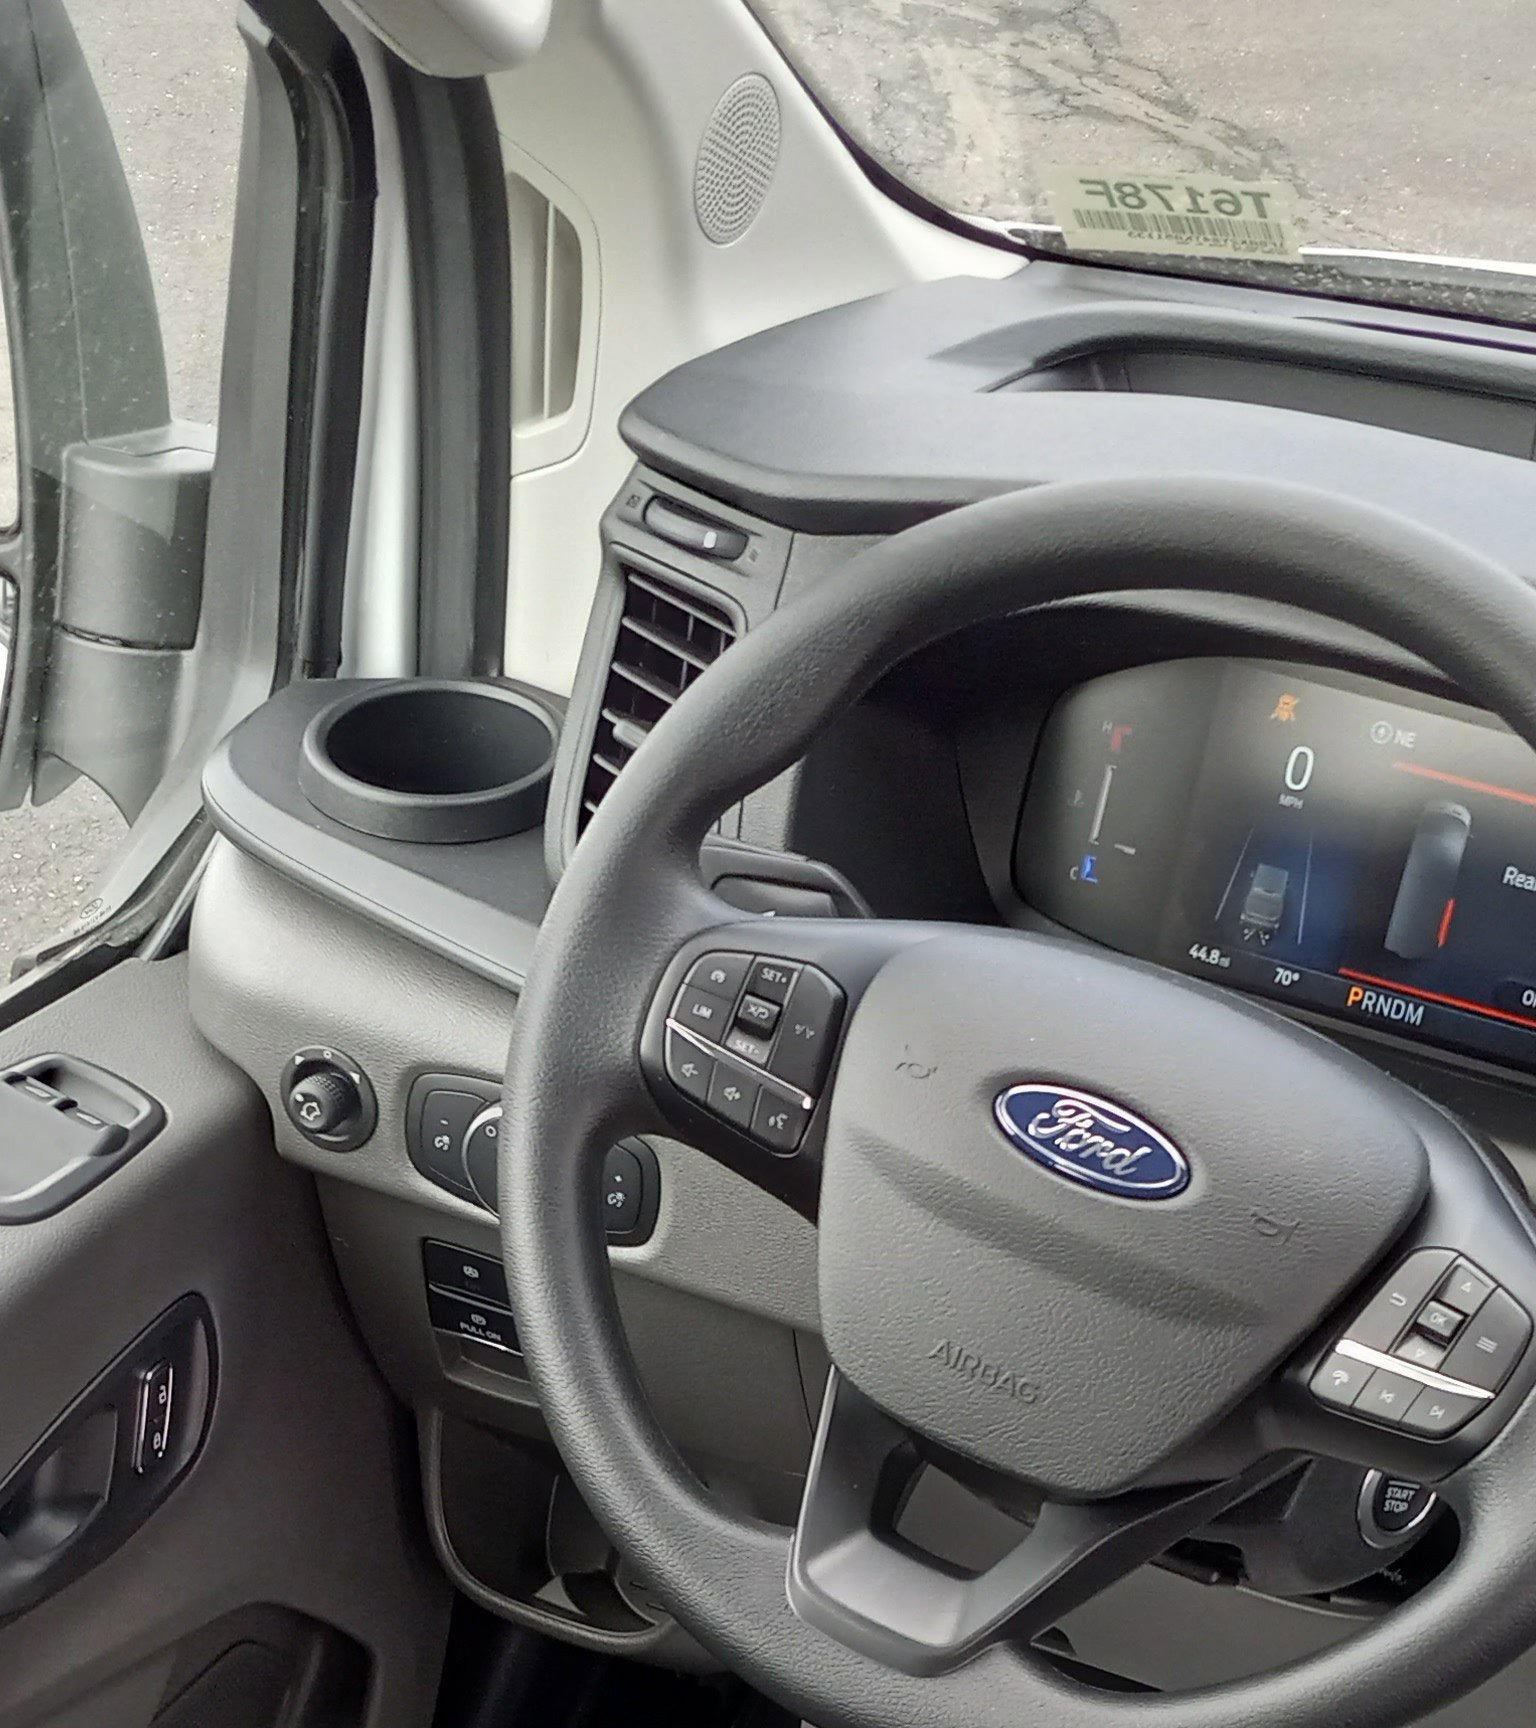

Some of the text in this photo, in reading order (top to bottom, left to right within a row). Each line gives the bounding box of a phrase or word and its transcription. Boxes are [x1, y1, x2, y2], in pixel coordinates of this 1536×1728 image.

[1394, 731, 1417, 748] NE
[1284, 745, 1315, 792] 0
[1278, 793, 1304, 811] MPH
[1028, 1098, 1152, 1176] Ford
[459, 1321, 502, 1341] PULL ON
[928, 1338, 1041, 1405] AIRBAG
[1385, 1485, 1415, 1501] START
[1383, 1499, 1409, 1513] STOP
